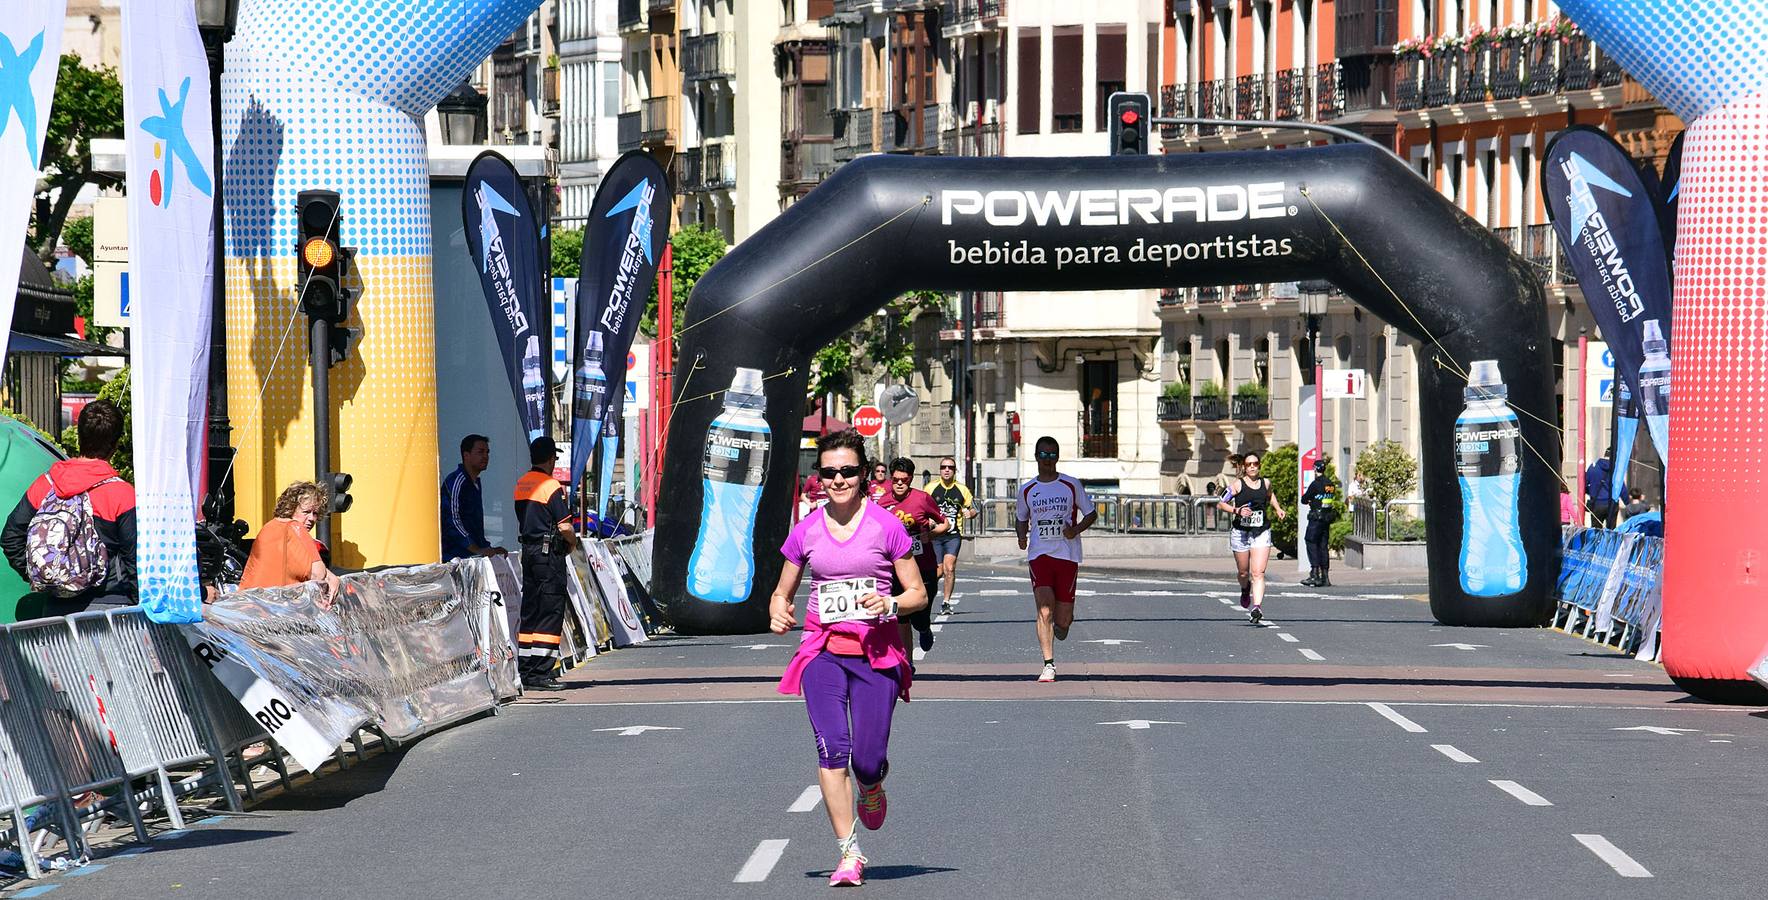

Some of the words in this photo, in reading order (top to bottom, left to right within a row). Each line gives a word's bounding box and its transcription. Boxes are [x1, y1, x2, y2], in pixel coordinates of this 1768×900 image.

[942, 181, 1287, 227] POWERADE
[601, 184, 656, 329] POWERADE
[948, 240, 1047, 265] bebida
[1057, 243, 1120, 270] para
[1128, 234, 1293, 268] deportistas
[610, 301, 628, 335] bebida
[624, 275, 637, 301] para
[855, 417, 881, 427] STOP
[708, 434, 770, 450] POWERADE
[1456, 428, 1519, 441] POWERADE
[1032, 498, 1047, 507] RUN
[1048, 496, 1068, 505] NOW
[1039, 526, 1061, 536] 2111
